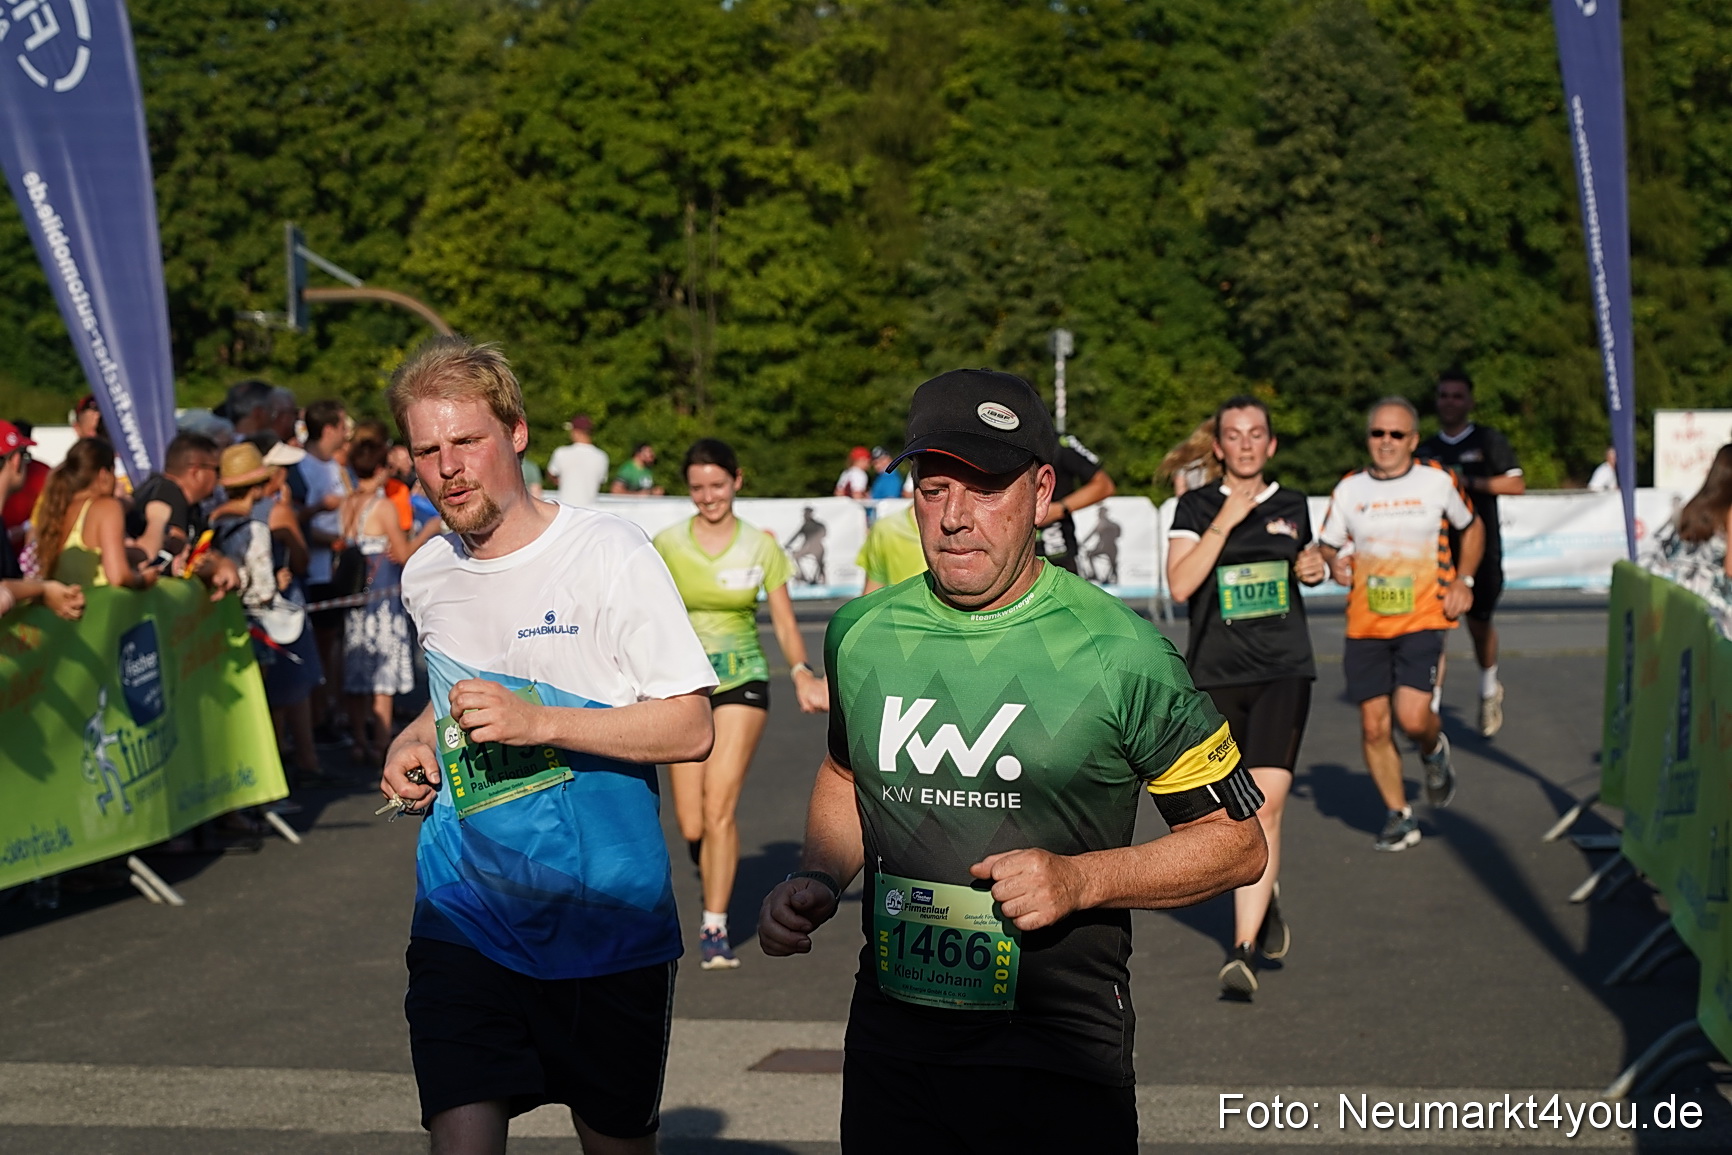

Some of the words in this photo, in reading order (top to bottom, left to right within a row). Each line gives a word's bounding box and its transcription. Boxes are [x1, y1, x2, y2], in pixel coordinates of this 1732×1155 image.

[1233, 581, 1278, 600] 1078
[970, 592, 1035, 622] #teamkwenergie
[449, 762, 466, 798] RUN
[470, 772, 498, 794] Pauli
[499, 763, 538, 784] Florian
[882, 785, 914, 803] KW
[920, 788, 1022, 809] ENERGIE
[904, 903, 950, 915] Firmenlauf
[880, 930, 889, 971] RUN
[892, 920, 992, 971] 1466
[894, 963, 924, 981] Klebl
[927, 969, 983, 989] Johann
[994, 940, 1012, 994] 2022
